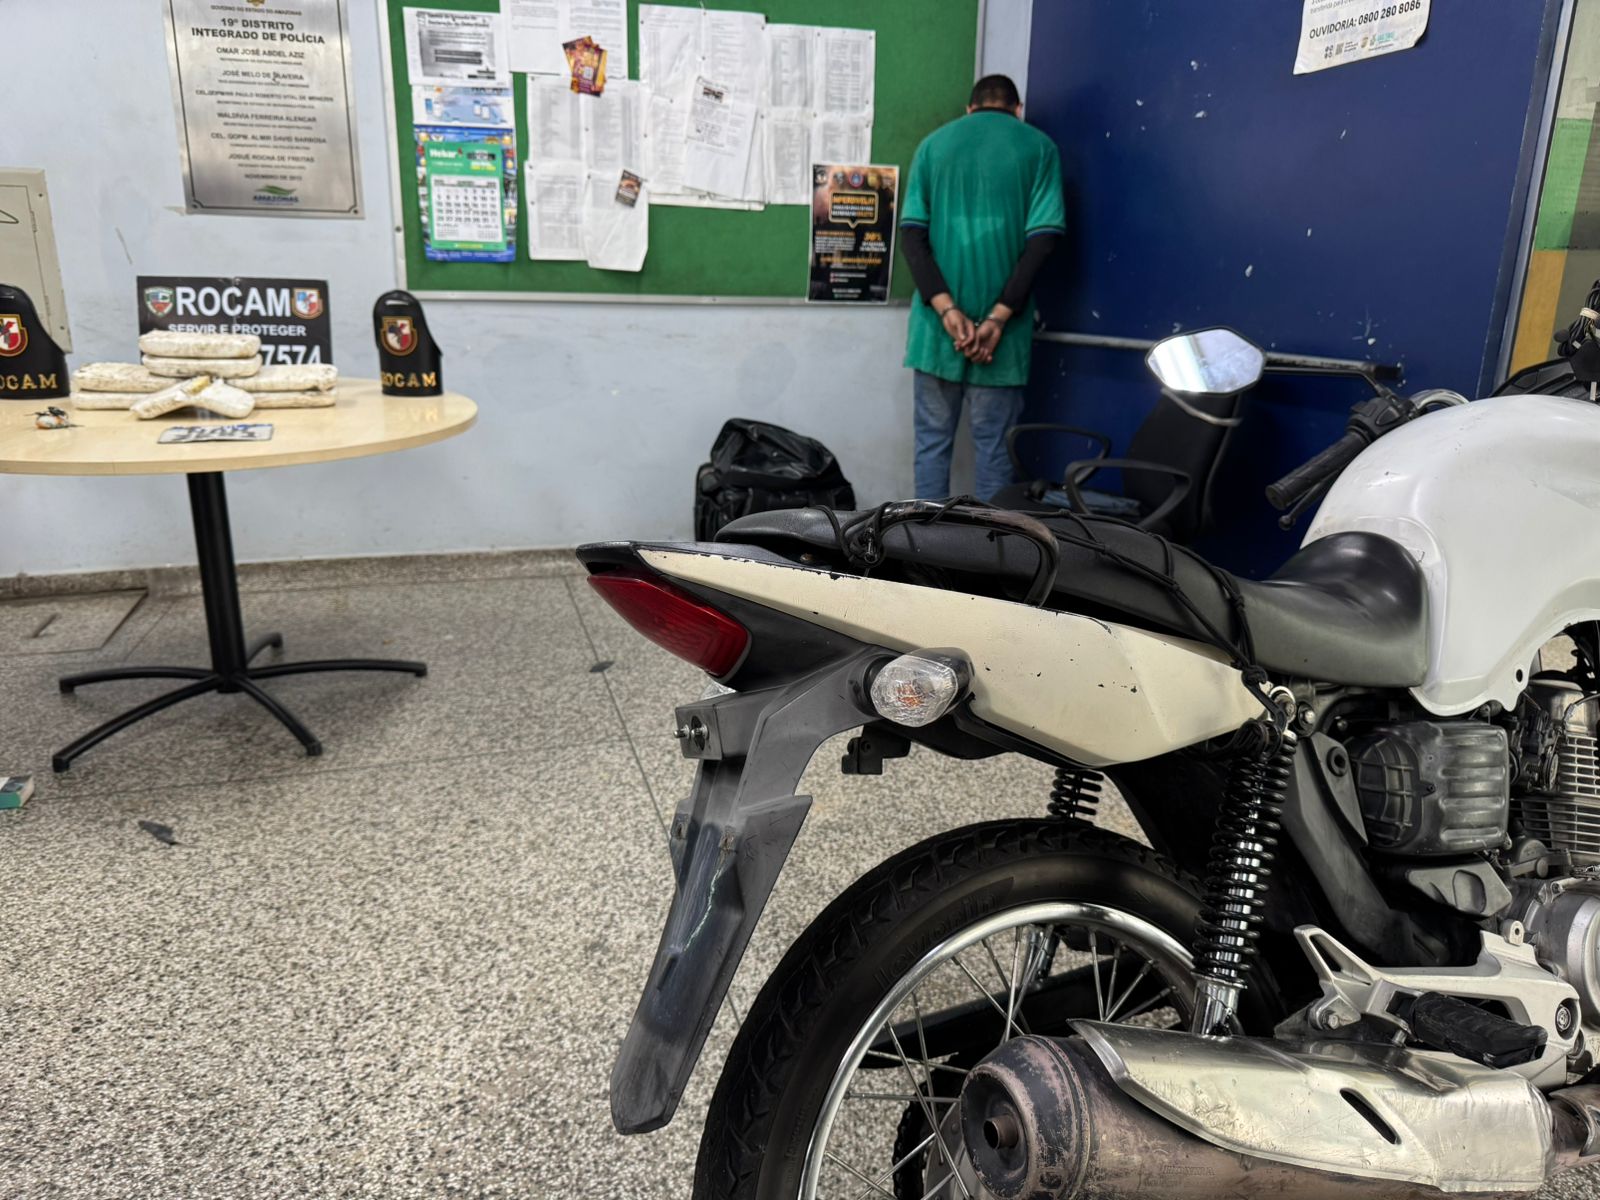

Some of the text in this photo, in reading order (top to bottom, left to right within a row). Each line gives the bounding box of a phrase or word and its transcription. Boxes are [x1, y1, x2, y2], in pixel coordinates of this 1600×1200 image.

[242, 19, 294, 30] DISTRITO
[1309, 0, 1421, 39] OUVIDORIA: 0800 280 8086
[191, 27, 325, 44] INTEGRADO DE POLÍCIA
[216, 46, 305, 59] OMAR JOSÉ ABDEL AZIZ
[175, 286, 291, 317] ROCAM
[168, 324, 307, 336] SERVIR E PROTEGER
[262, 344, 321, 366] 7574
[0, 374, 58, 390] CAM
